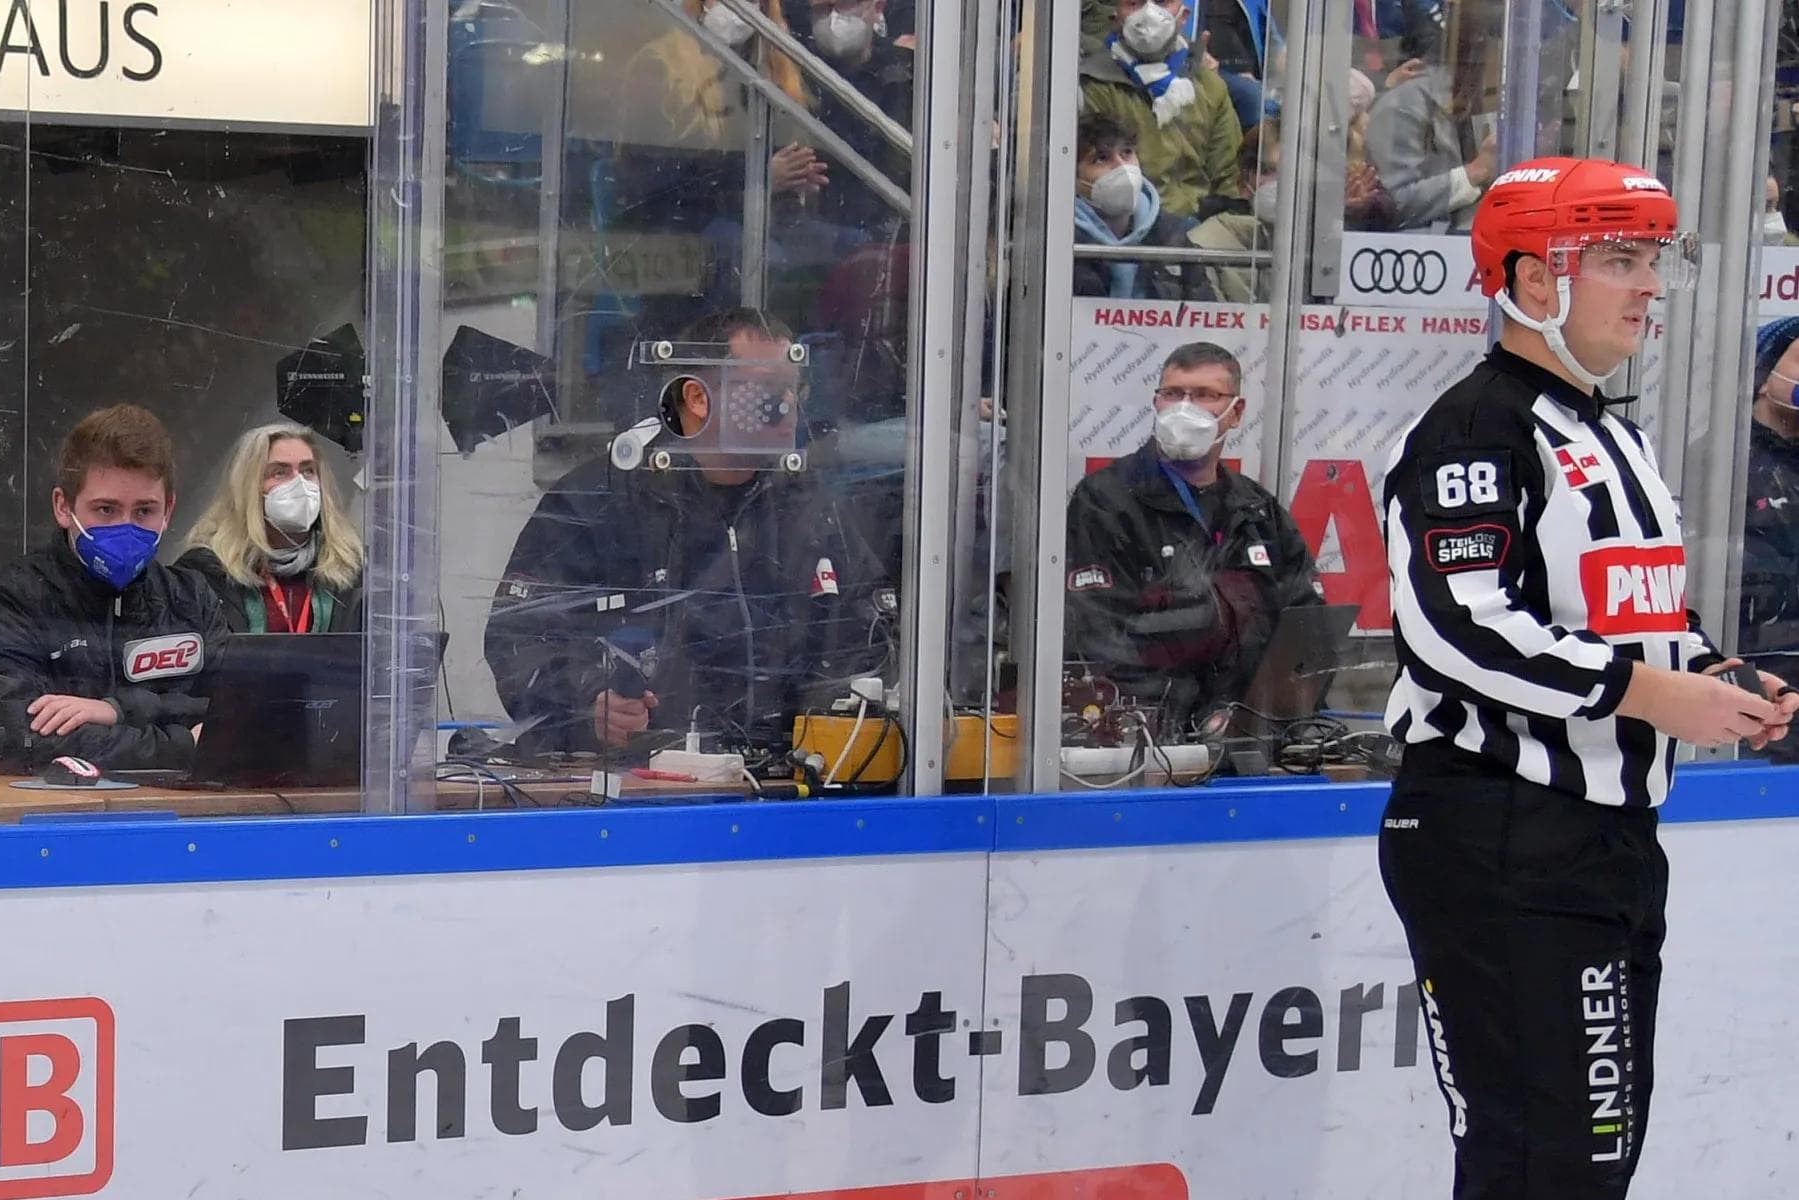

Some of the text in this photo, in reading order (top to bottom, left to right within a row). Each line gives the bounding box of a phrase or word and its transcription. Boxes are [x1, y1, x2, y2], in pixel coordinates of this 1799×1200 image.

[1436, 461, 1499, 508] 68
[130, 641, 199, 675] DEL
[1618, 960, 1633, 1048] RESORTS
